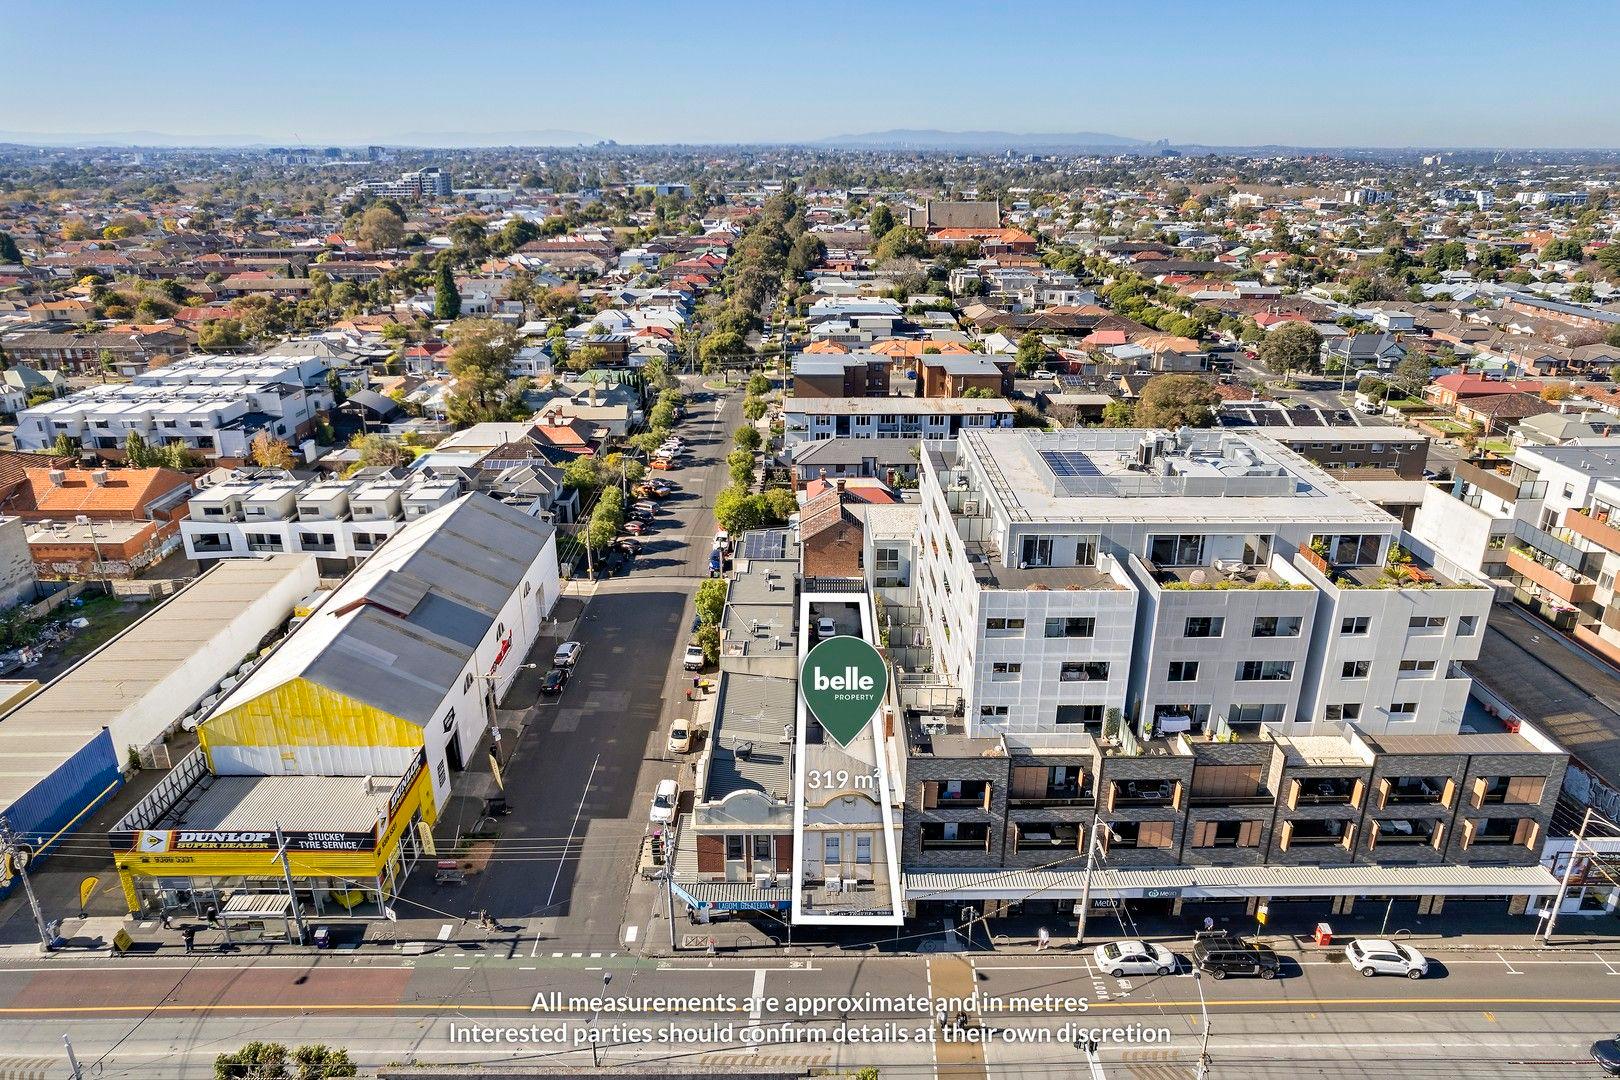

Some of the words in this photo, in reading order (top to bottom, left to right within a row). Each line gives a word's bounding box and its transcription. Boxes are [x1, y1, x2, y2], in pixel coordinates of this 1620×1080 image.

[178, 832, 271, 842] DUNLOP
[307, 832, 345, 841] STUCKEY
[299, 841, 321, 849] TYRE
[323, 841, 357, 849] SERVICE
[1095, 899, 1118, 907] Metro
